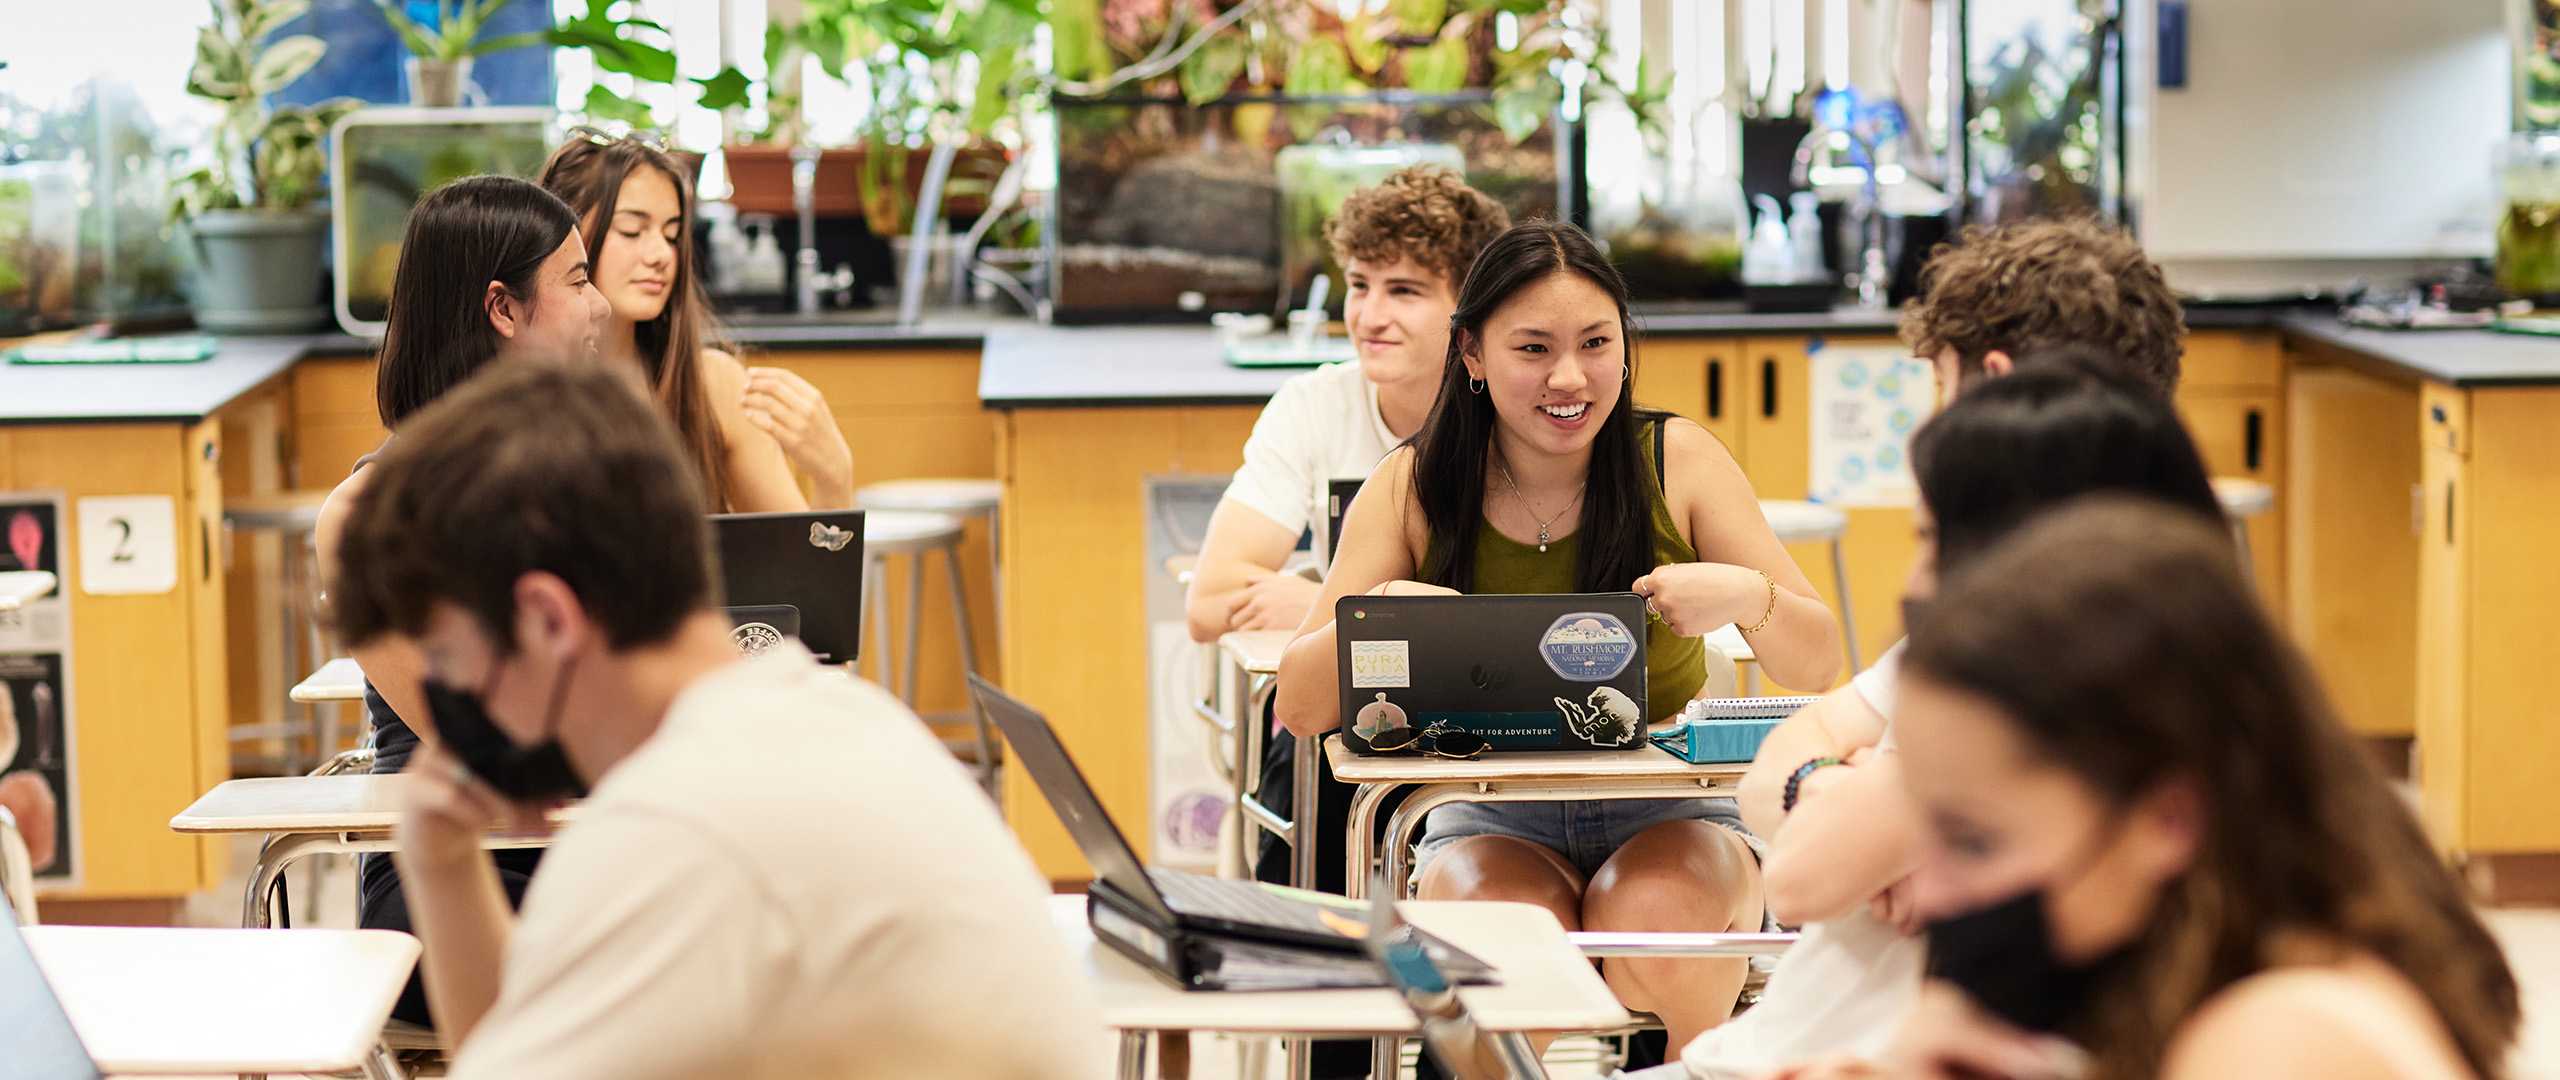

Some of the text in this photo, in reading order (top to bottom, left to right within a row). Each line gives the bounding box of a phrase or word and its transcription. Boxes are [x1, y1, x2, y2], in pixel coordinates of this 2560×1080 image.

[108, 516, 136, 563] 2
[1572, 644, 1626, 654] RUSHMORE
[1355, 655, 1406, 664] PURA
